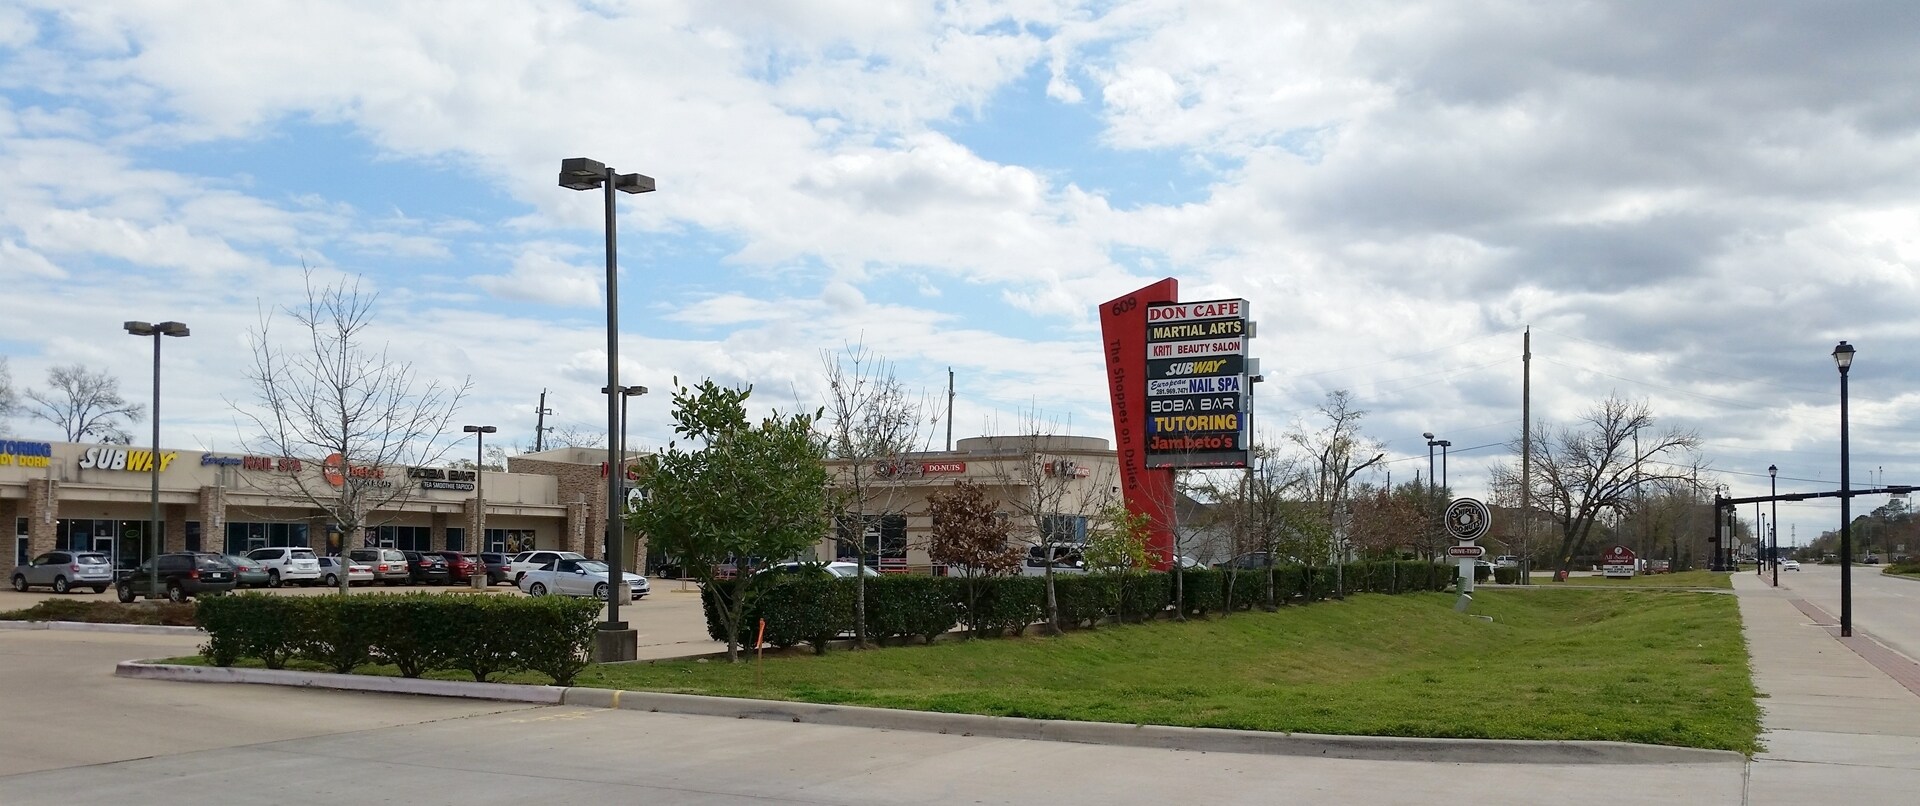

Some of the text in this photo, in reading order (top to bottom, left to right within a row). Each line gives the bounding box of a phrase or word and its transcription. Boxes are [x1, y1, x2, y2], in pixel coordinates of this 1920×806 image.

[1112, 297, 1137, 316] 609
[1149, 302, 1239, 320] DON CAFE
[1153, 320, 1242, 339] MARTIAL ARTS
[1110, 339, 1121, 364] The
[1153, 341, 1240, 357] KRITI BEAUTY SALON
[1165, 359, 1227, 377] SUBWAY
[1150, 378, 1187, 391] European
[1189, 377, 1240, 393] NAIL SPA
[1113, 367, 1129, 424] Shoppes
[1150, 397, 1234, 413] BOBA BAR
[1154, 413, 1237, 432] TUTORING
[1121, 427, 1131, 445] on
[1151, 434, 1233, 450] Jambeto's
[79, 447, 178, 472] SUBWAY
[242, 456, 274, 472] NAIL
[929, 464, 960, 472] DO-NUTS
